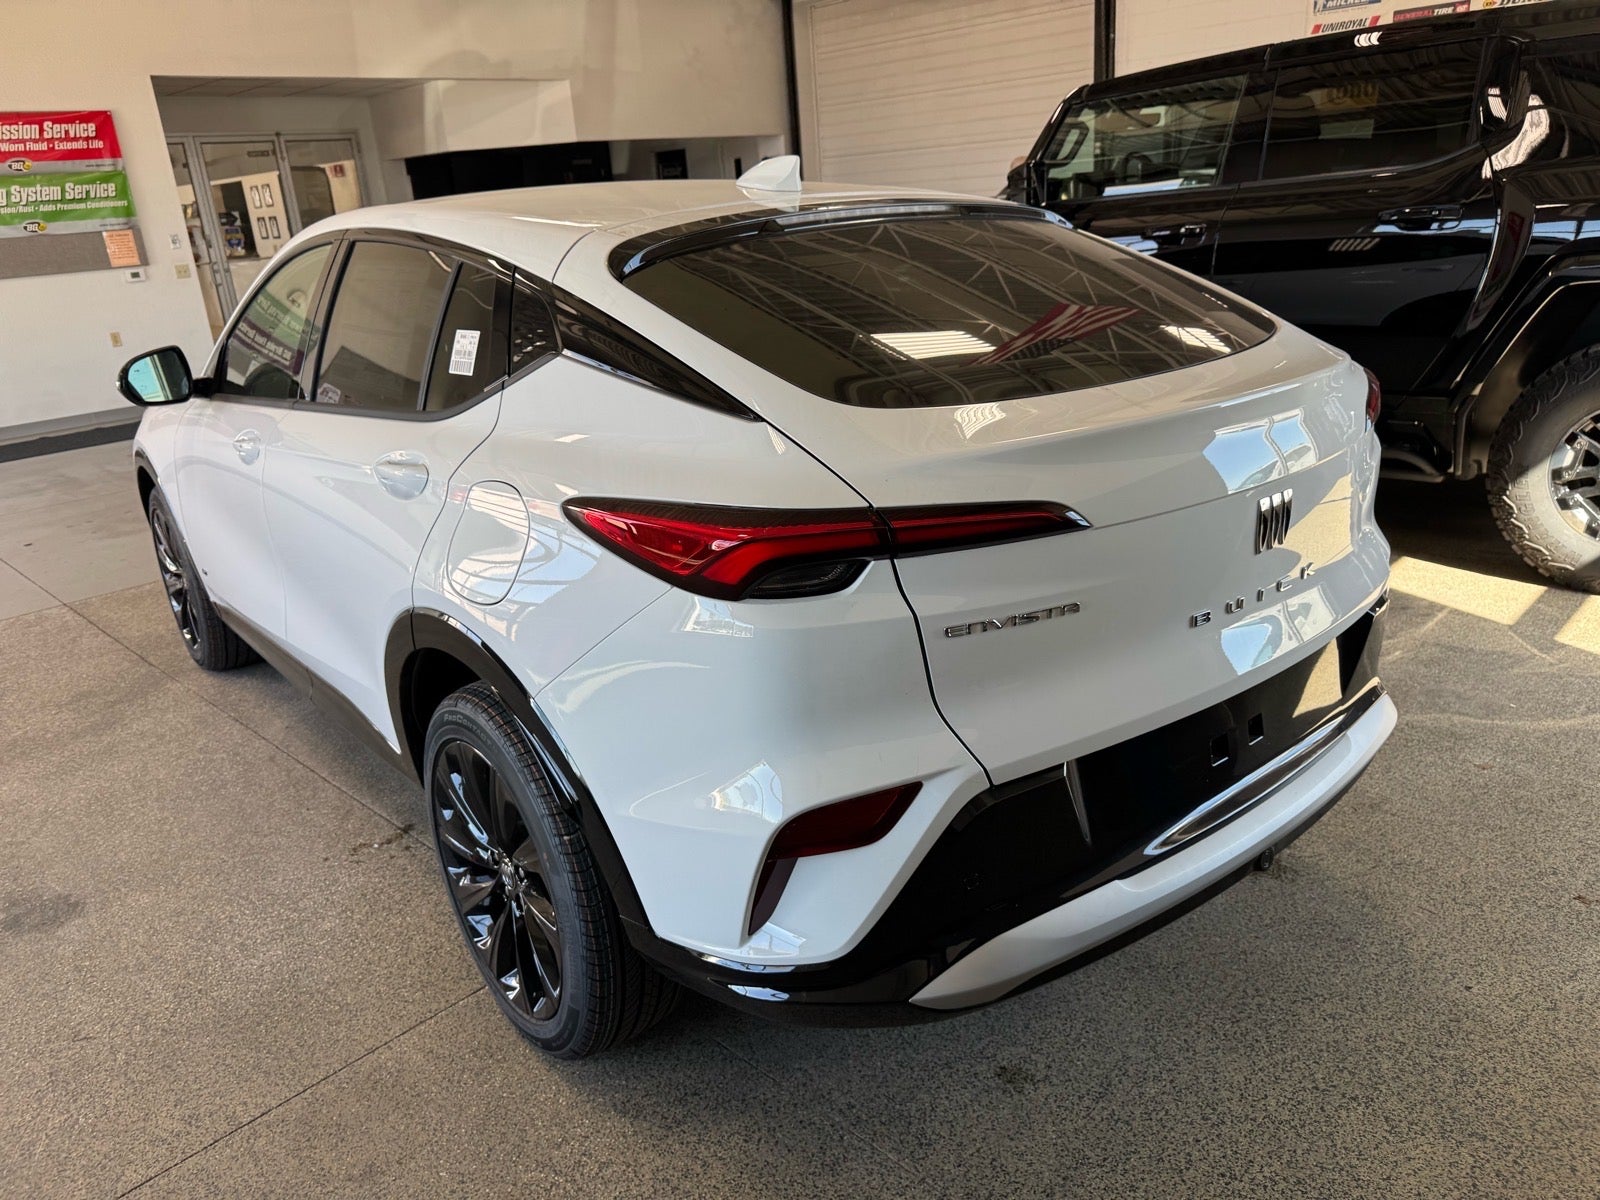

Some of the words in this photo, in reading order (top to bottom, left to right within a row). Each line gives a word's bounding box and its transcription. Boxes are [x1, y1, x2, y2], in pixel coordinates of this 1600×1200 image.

[1433, 6, 1455, 16] TIRE
[1321, 17, 1368, 33] UNIROYAL
[43, 120, 96, 139] Service
[26, 141, 48, 151] Fluid
[54, 140, 88, 150] Extends
[89, 140, 104, 149] Life
[11, 184, 62, 206] System
[65, 181, 117, 200] Service
[40, 204, 56, 212] Adds
[57, 202, 86, 211] Premium
[87, 200, 128, 209] Conditioners
[1190, 562, 1316, 628] BUICK
[944, 601, 1082, 640] ENVISTA
